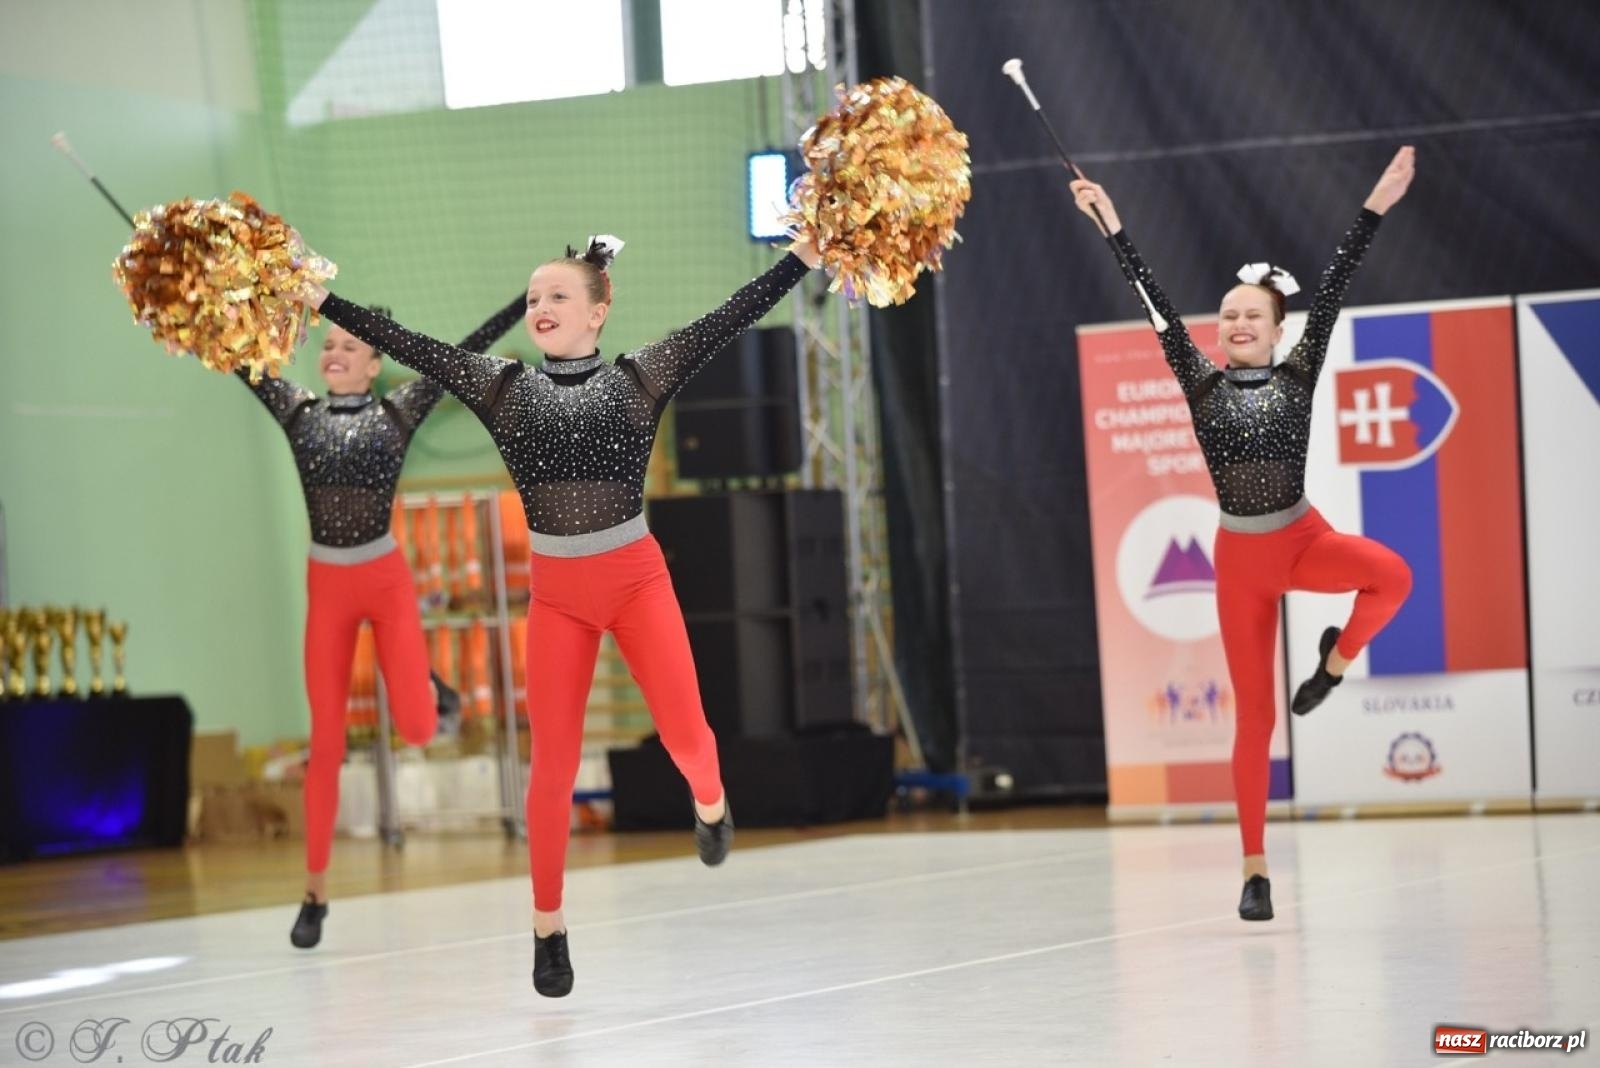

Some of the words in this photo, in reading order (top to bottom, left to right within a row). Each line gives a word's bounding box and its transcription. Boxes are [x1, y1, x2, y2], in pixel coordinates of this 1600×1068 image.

[1111, 427, 1196, 455] MAJORE
[1362, 694, 1455, 713] SLOVAKIA
[1572, 688, 1600, 707] CZ
